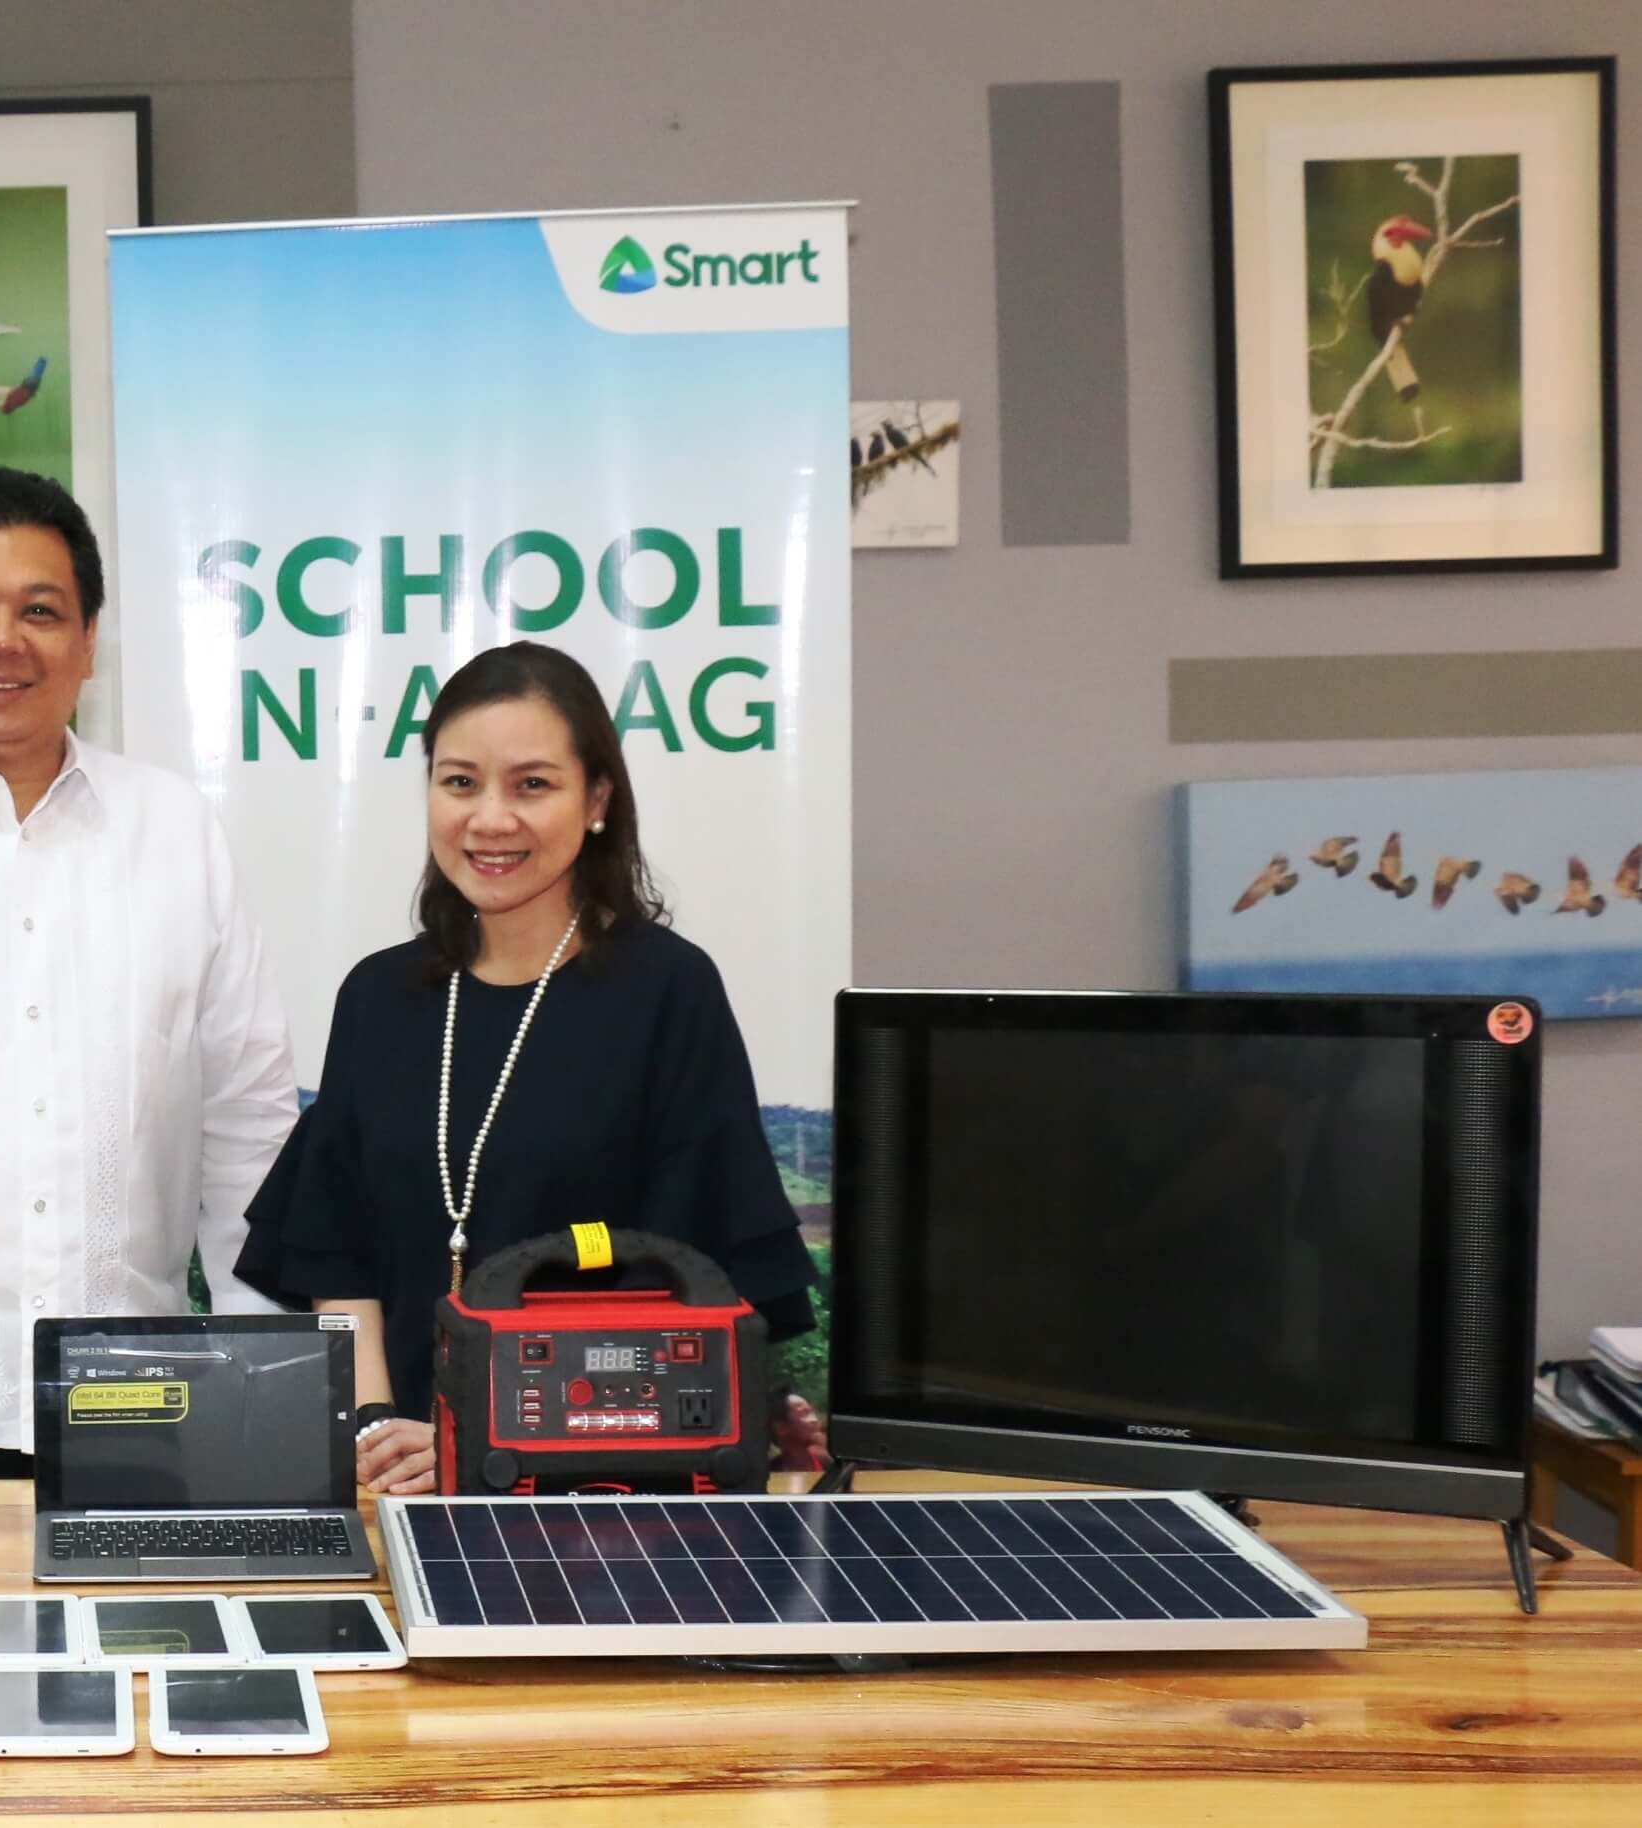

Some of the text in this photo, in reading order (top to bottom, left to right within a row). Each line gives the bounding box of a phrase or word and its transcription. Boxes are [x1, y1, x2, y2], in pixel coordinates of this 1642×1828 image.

[664, 240, 819, 287] Smart
[197, 526, 783, 640] SCHOOL
[1127, 1425, 1190, 1438] PENSONIC
